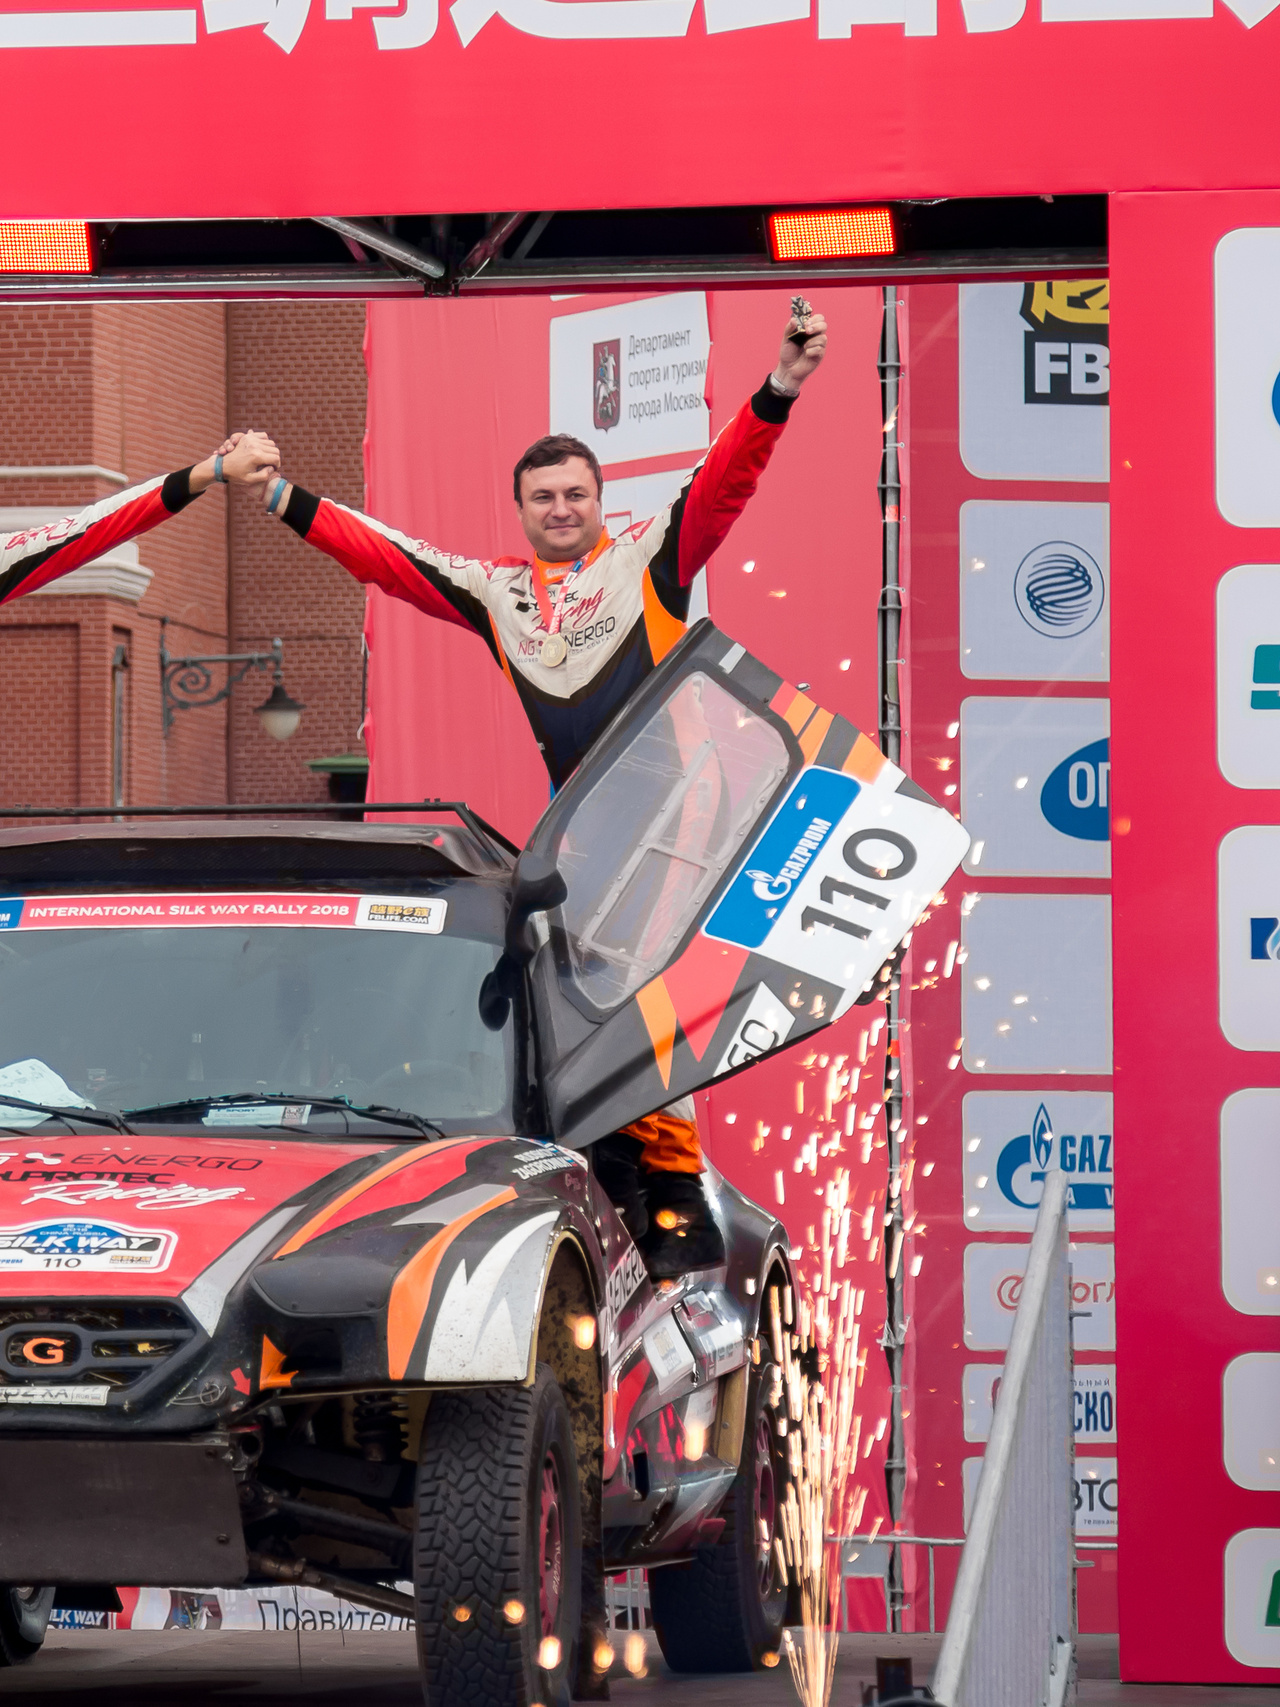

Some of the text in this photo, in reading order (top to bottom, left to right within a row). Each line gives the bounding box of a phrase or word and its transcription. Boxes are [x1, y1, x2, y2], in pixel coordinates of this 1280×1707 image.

[628, 330, 691, 360] Департамент
[628, 365, 661, 390] спорта
[663, 368, 670, 381] и
[628, 391, 702, 423] города Москвы
[518, 616, 616, 656] NG NERGO
[780, 817, 832, 880] GAZPROM
[801, 828, 918, 941] 110
[29, 904, 350, 918] INTERNATIONAL SILK WAY RALLY 2018
[368, 914, 430, 925] FBLIFE.COM
[70, 1153, 263, 1171] ENERGO
[1060, 1135, 1112, 1172] GAZ
[21, 1180, 246, 1210] Racing
[77, 1235, 155, 1250] WAY
[42, 1257, 81, 1268] 110
[22, 1337, 65, 1364] G
